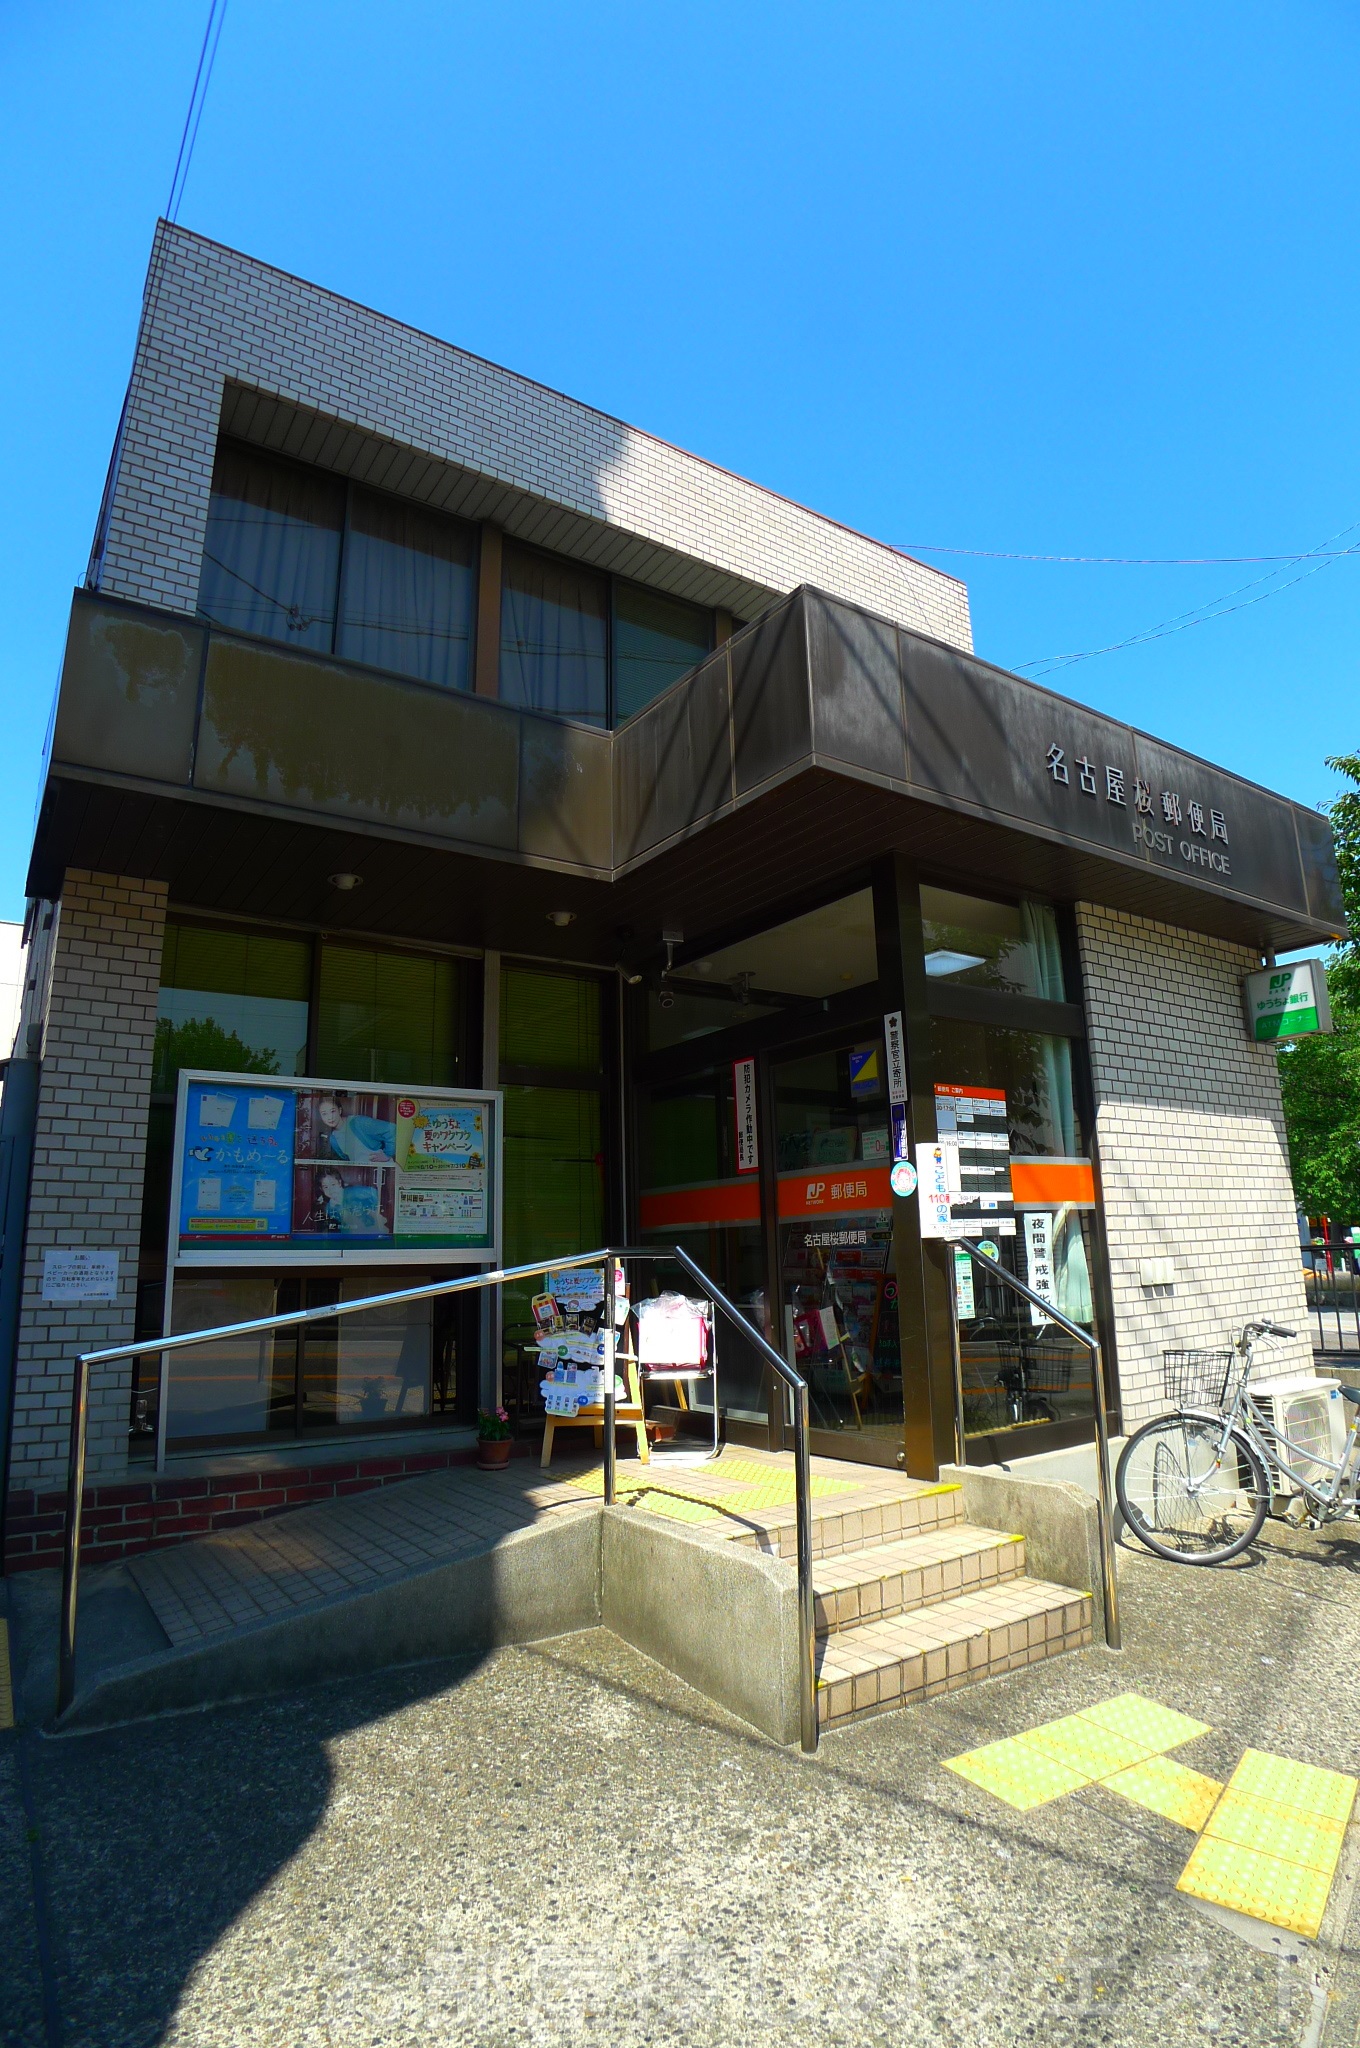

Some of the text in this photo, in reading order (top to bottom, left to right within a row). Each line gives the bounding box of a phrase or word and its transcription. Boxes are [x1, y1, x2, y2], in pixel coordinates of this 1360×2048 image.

[1045, 742, 1229, 845] 名古屋桜郵便局
[1132, 823, 1232, 876] POST OFFICE
[1269, 972, 1292, 990] JP
[1256, 991, 1309, 1011] ゆうちょ銀行
[1261, 1016, 1312, 1029] ATMコーナー
[890, 1030, 902, 1088] 警察官立寄所
[743, 1064, 753, 1164] 防犯カメラ作動中です
[431, 1118, 461, 1130] ゆうちょ
[424, 1129, 471, 1141] 夏のワクワク
[423, 1142, 473, 1153] キャンペーン
[806, 1182, 826, 1200] JP
[830, 1181, 868, 1200] 郵便局
[804, 1231, 867, 1247] 名古屋桜郵便局
